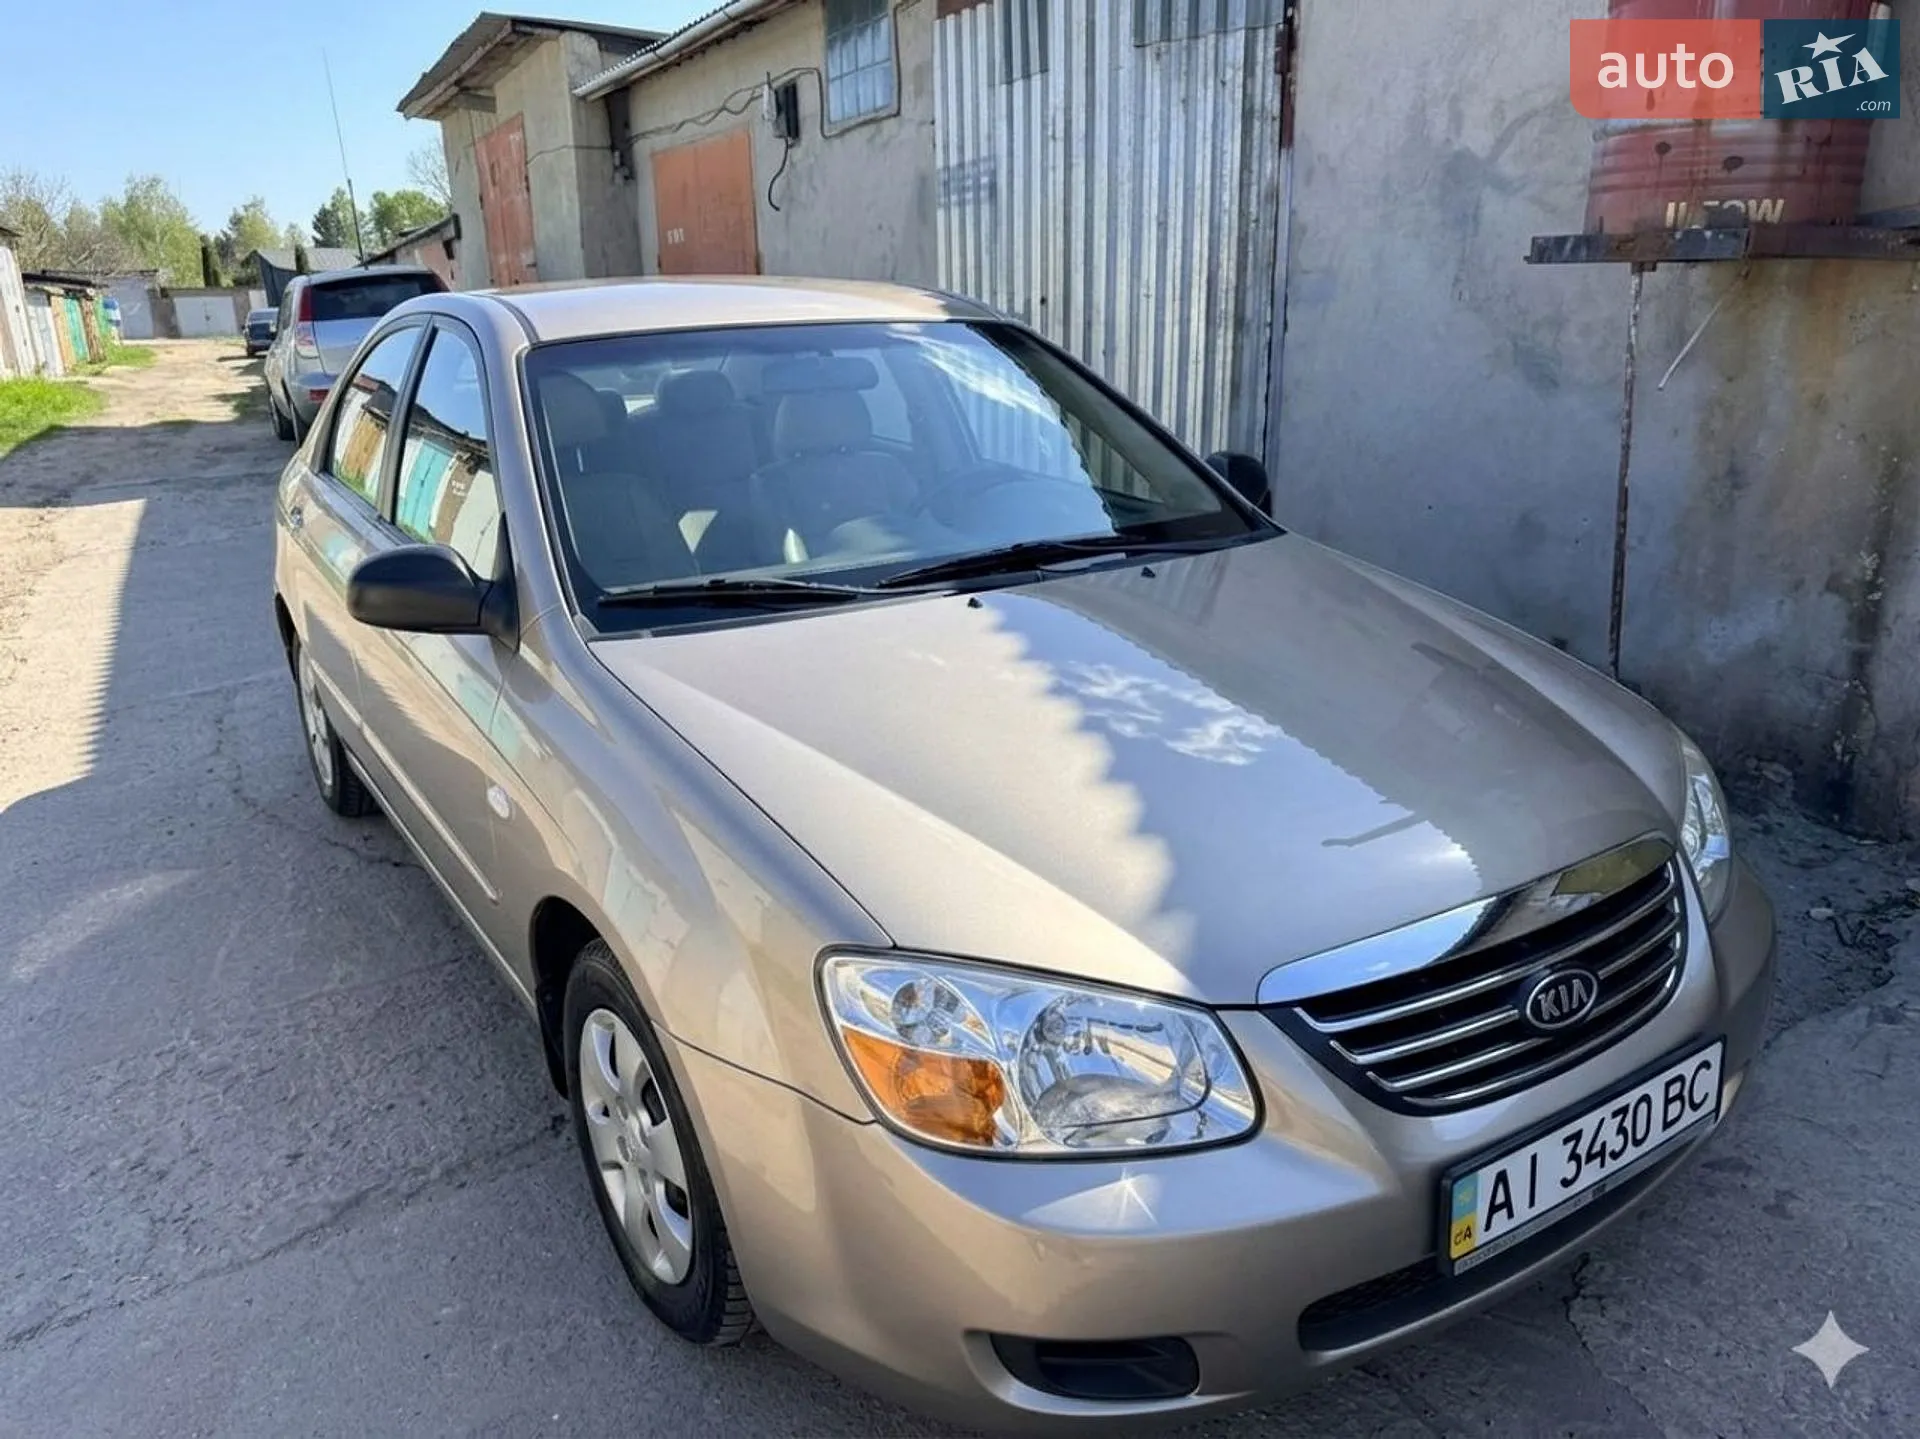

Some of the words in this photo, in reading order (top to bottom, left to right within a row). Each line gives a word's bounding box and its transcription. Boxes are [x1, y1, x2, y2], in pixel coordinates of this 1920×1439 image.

[1538, 979, 1588, 1021] KIA
[1485, 1152, 1537, 1232] AI
[1560, 1093, 1653, 1189] 3430
[1662, 1060, 1711, 1132] BC
